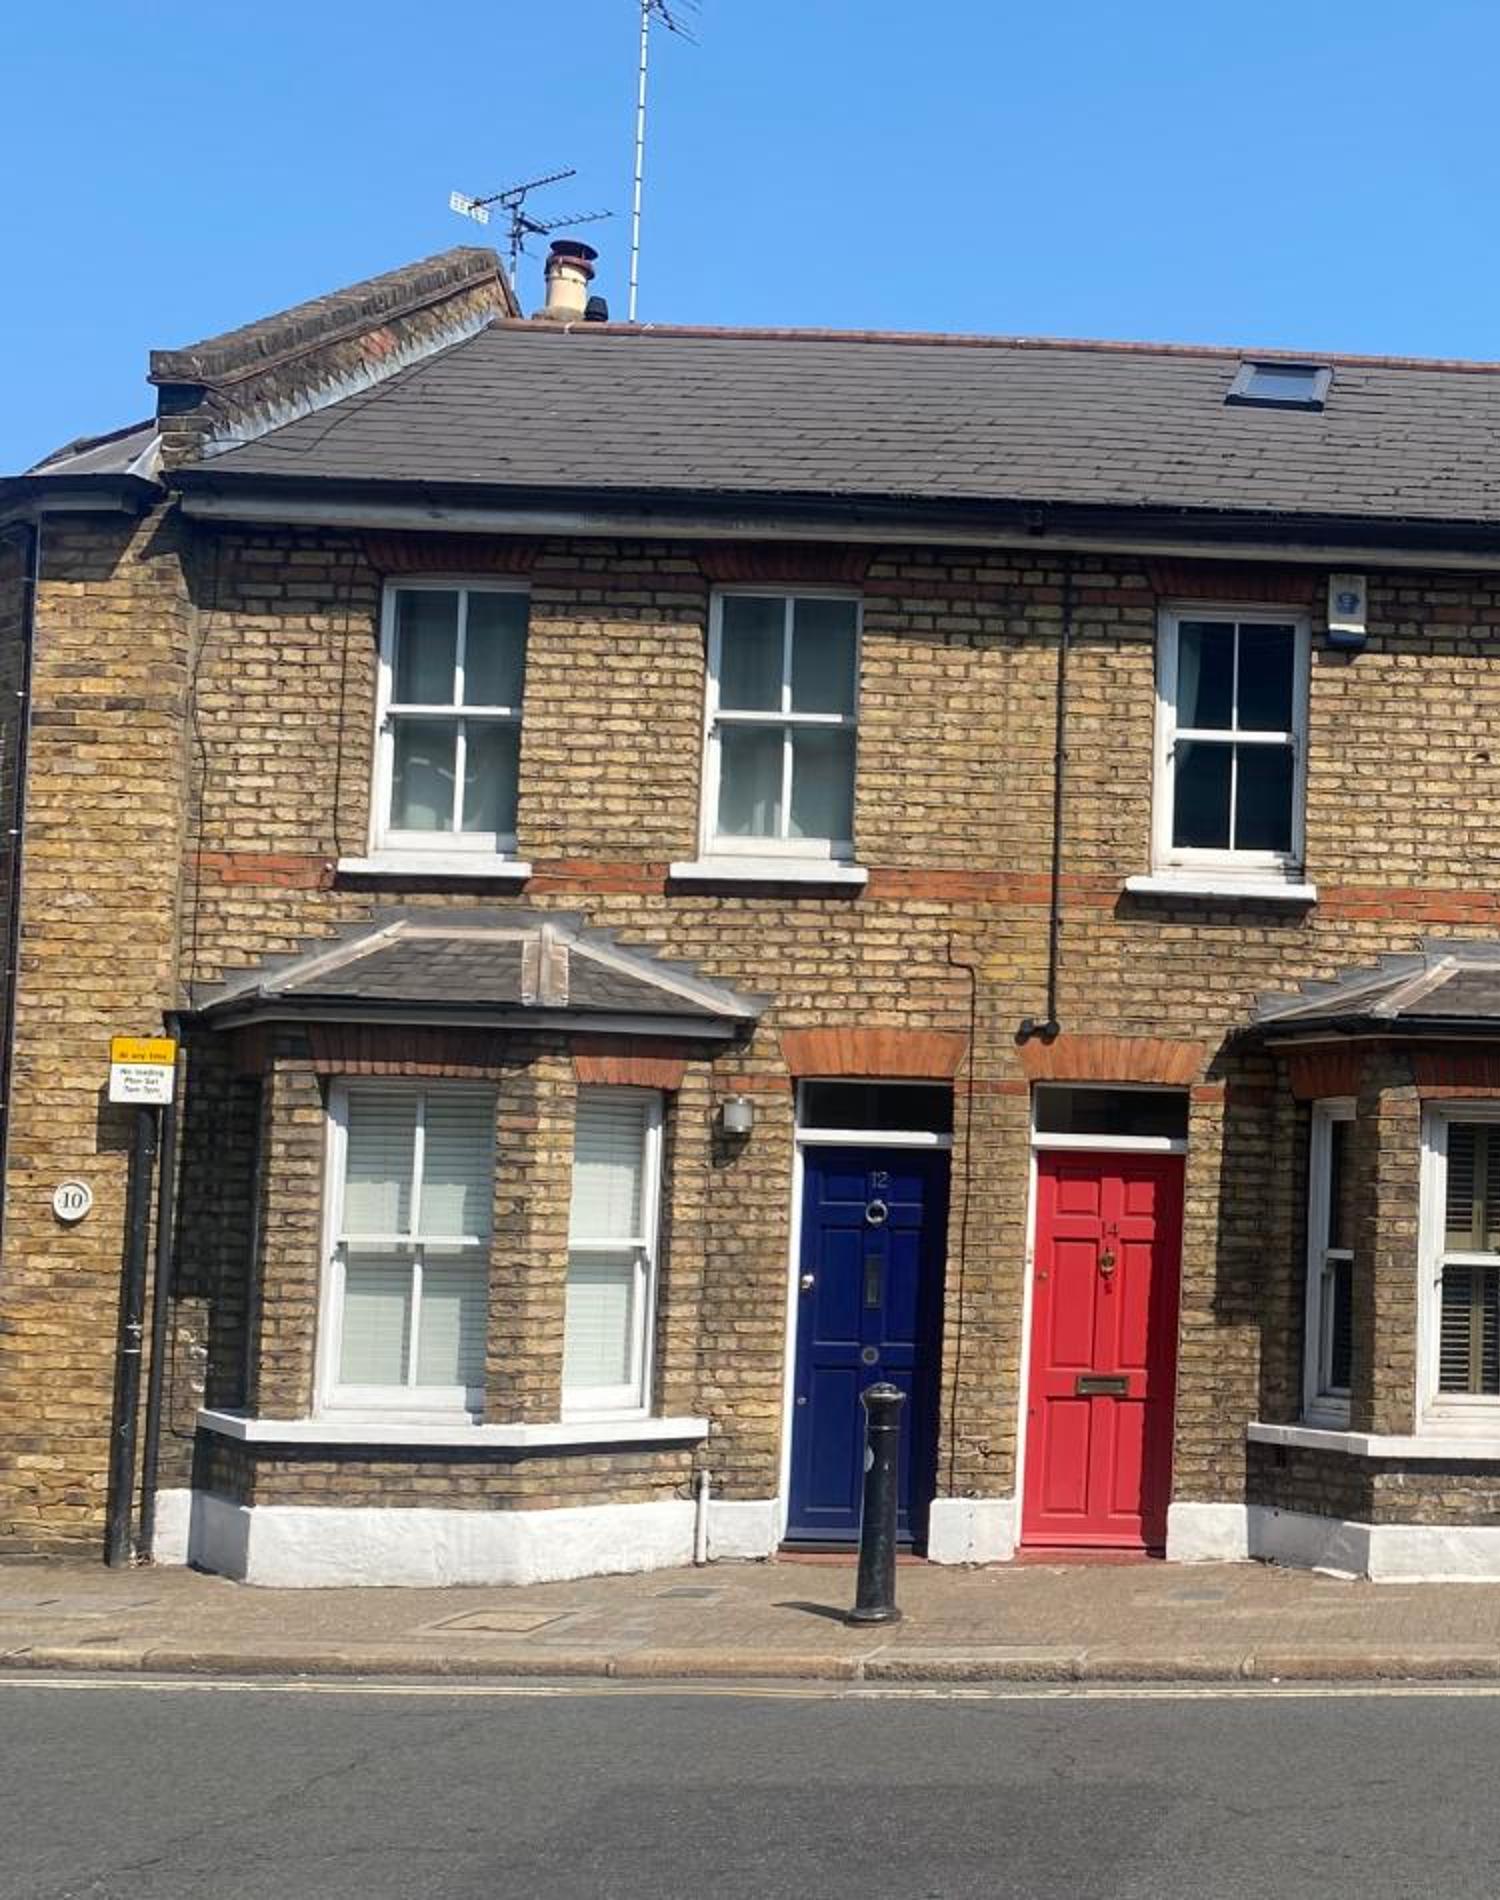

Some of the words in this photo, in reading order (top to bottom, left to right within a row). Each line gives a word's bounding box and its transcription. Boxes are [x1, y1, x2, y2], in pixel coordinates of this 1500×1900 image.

[134, 1068, 164, 1078] loading
[872, 1171, 889, 1189] 12
[63, 1192, 83, 1208] 10
[1101, 1221, 1119, 1238] 14
